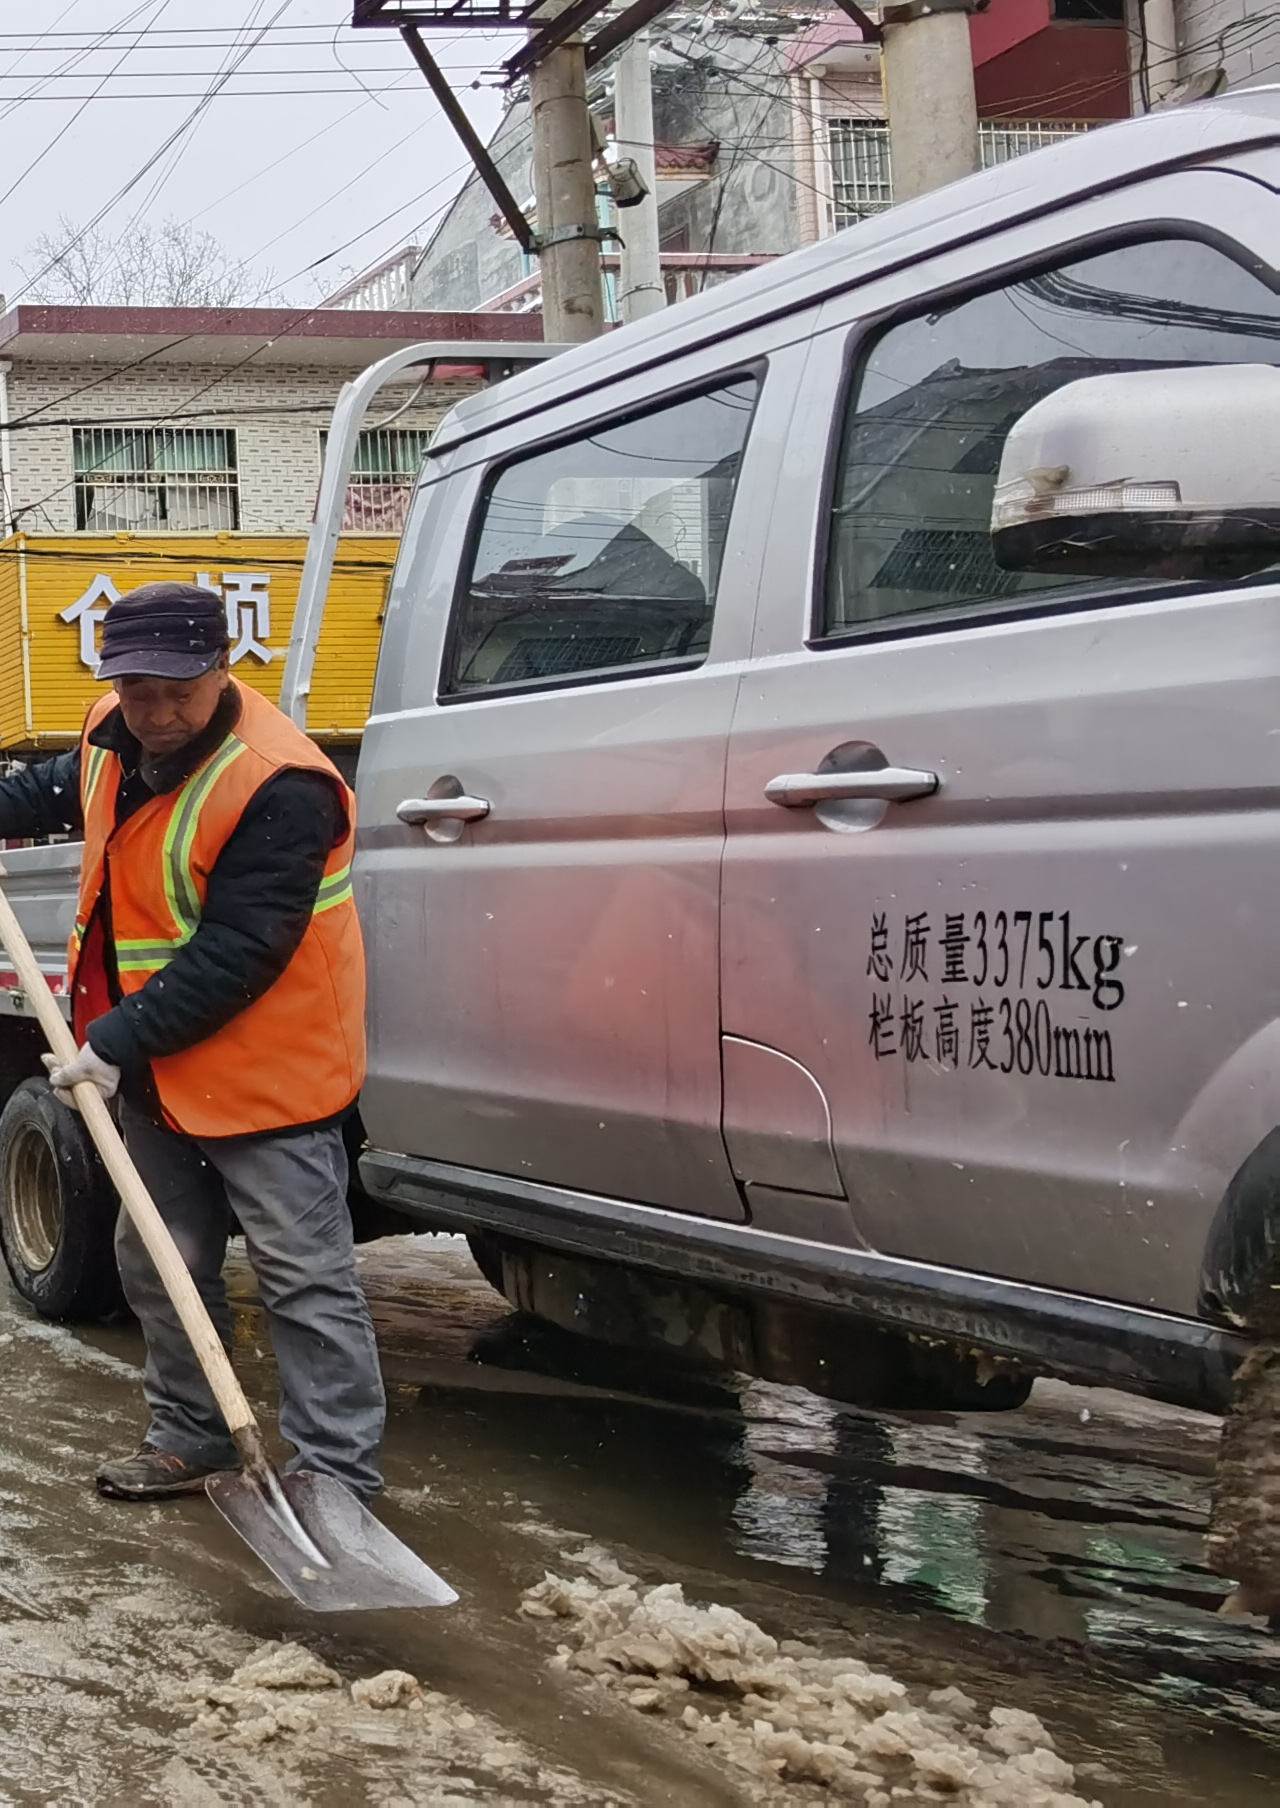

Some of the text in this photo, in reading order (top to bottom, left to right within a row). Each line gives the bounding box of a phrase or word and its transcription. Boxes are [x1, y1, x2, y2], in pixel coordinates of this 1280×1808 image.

[866, 910, 1125, 1011] 总质量3375kg
[868, 991, 1116, 1083] 栏板高度380mm
